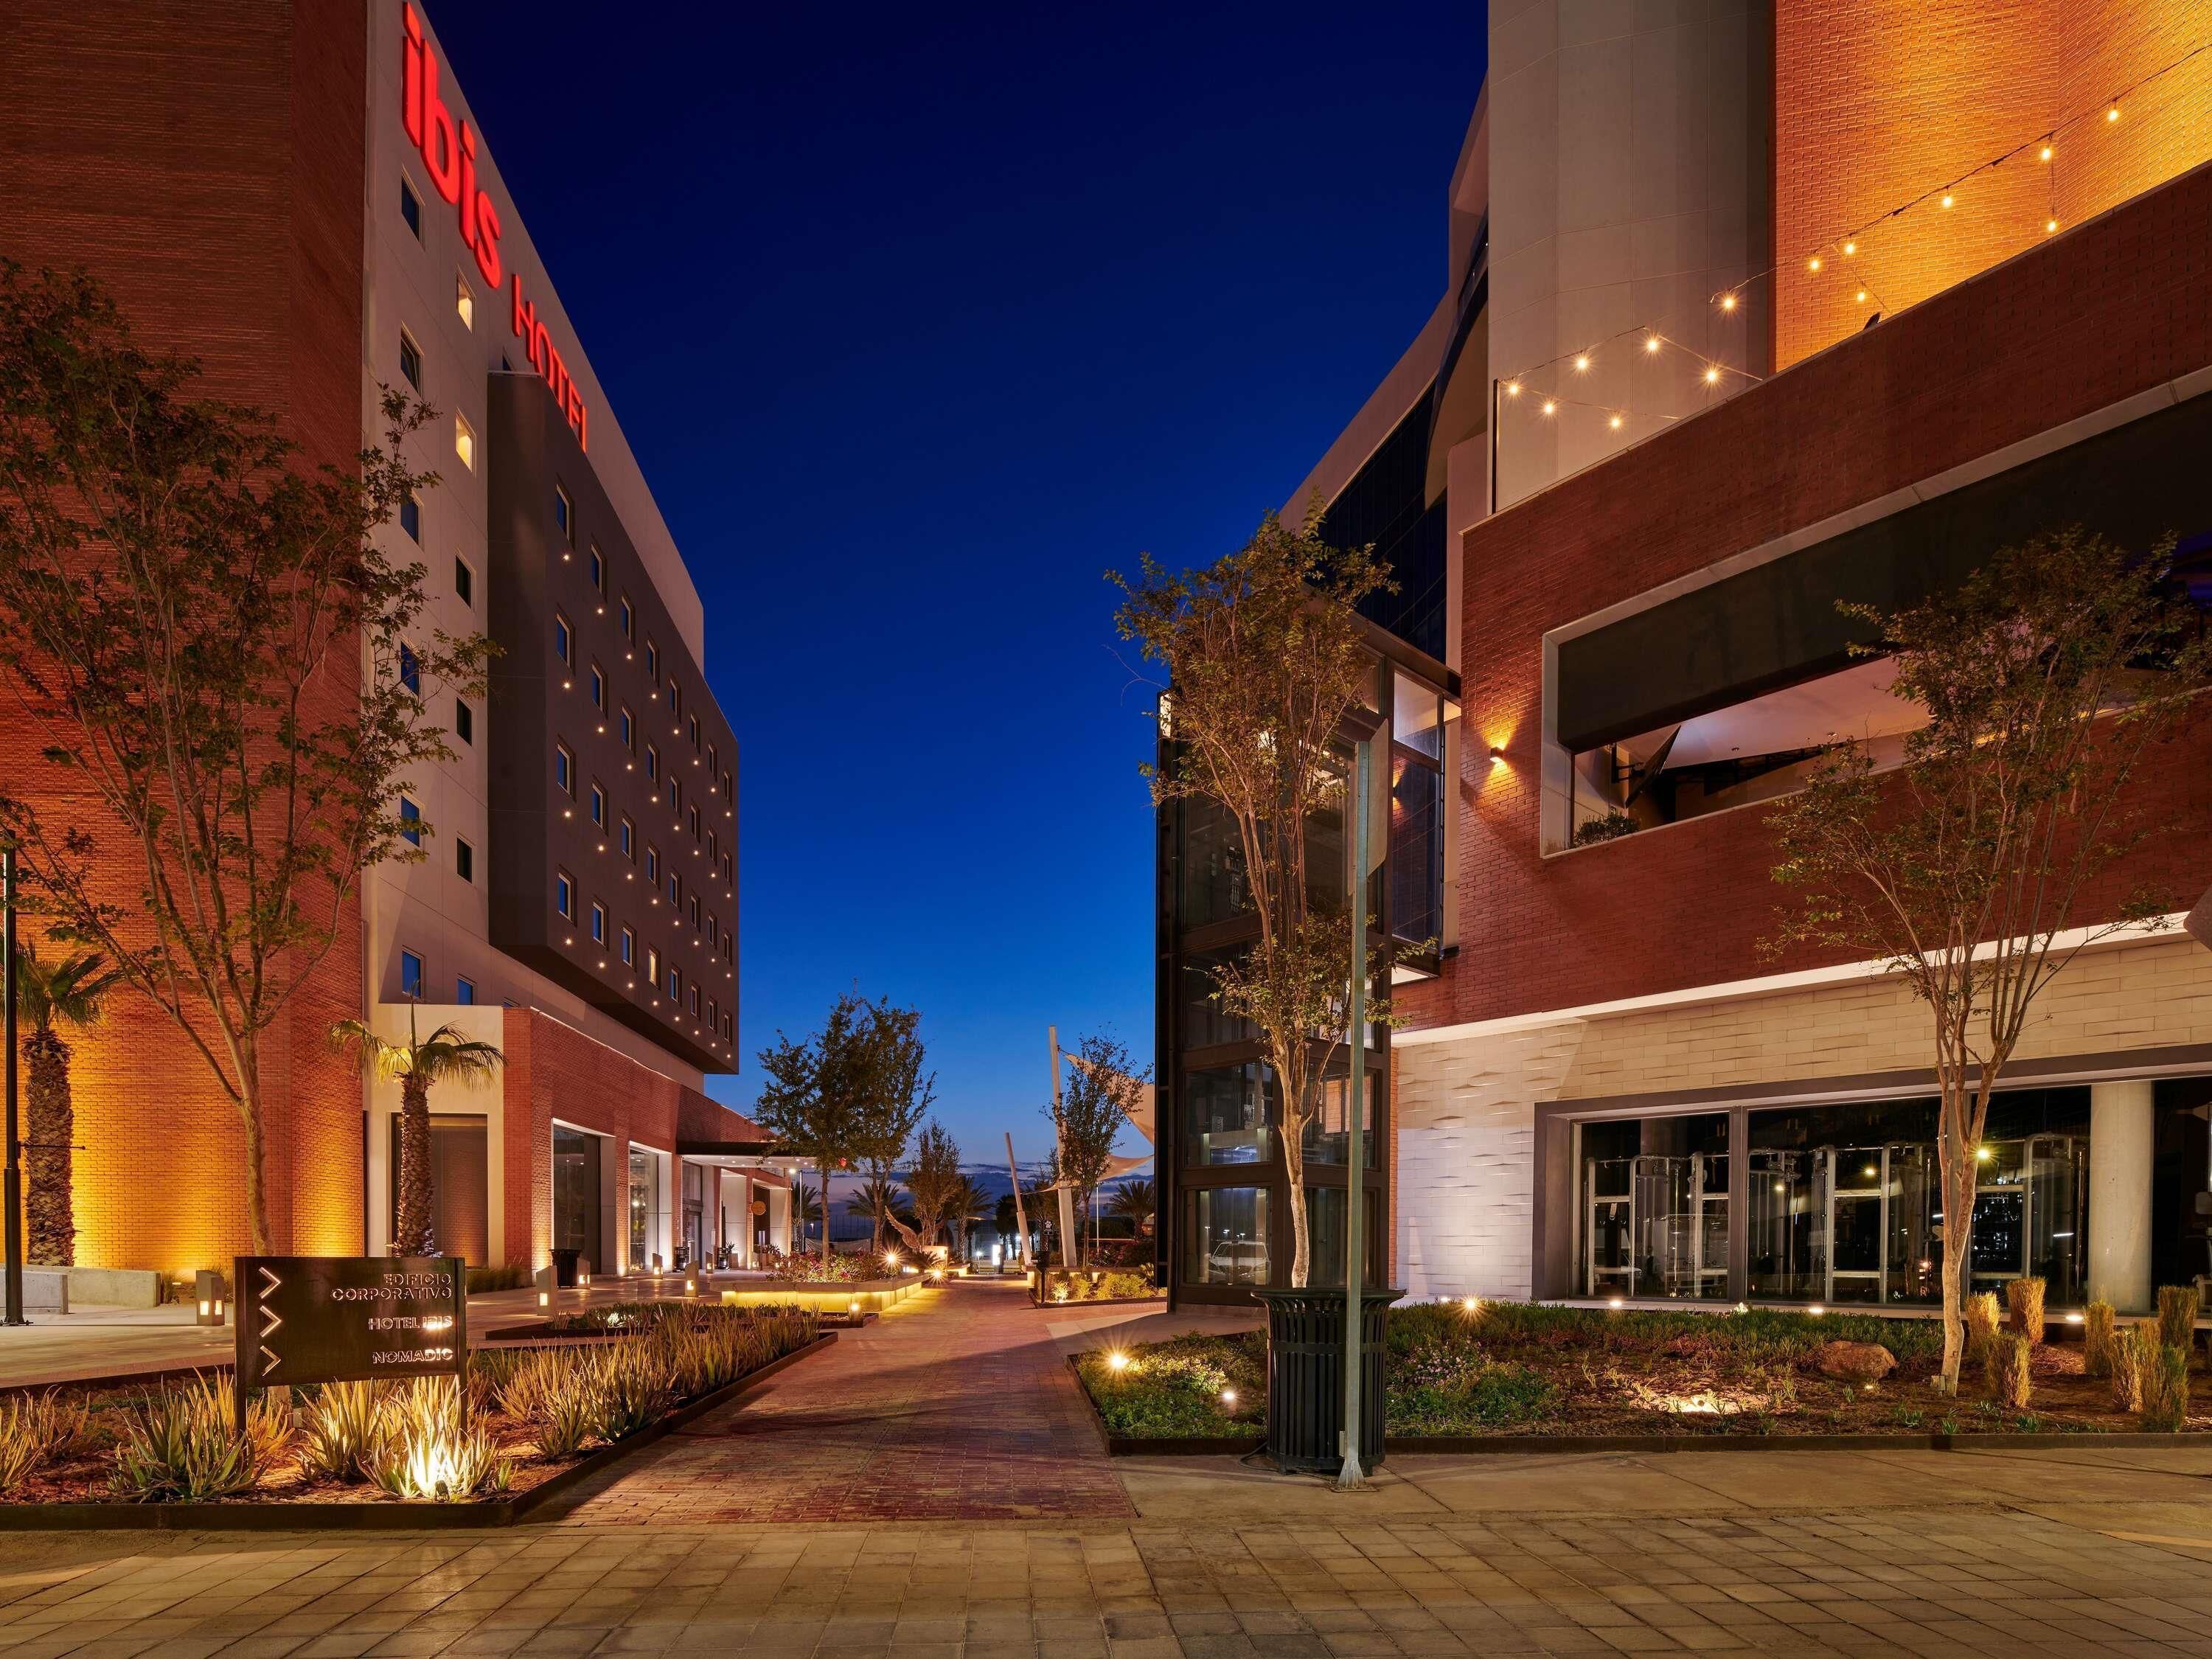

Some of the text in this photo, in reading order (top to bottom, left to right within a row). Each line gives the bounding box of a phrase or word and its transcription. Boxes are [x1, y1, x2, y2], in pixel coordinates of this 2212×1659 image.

[403, 1, 501, 289] ibis
[383, 1273, 451, 1285] EDIFICIO
[332, 1287, 452, 1300] CORPORATIVO
[368, 1315, 453, 1330] HOTEL IBIS
[372, 1348, 453, 1364] NOMADIC
